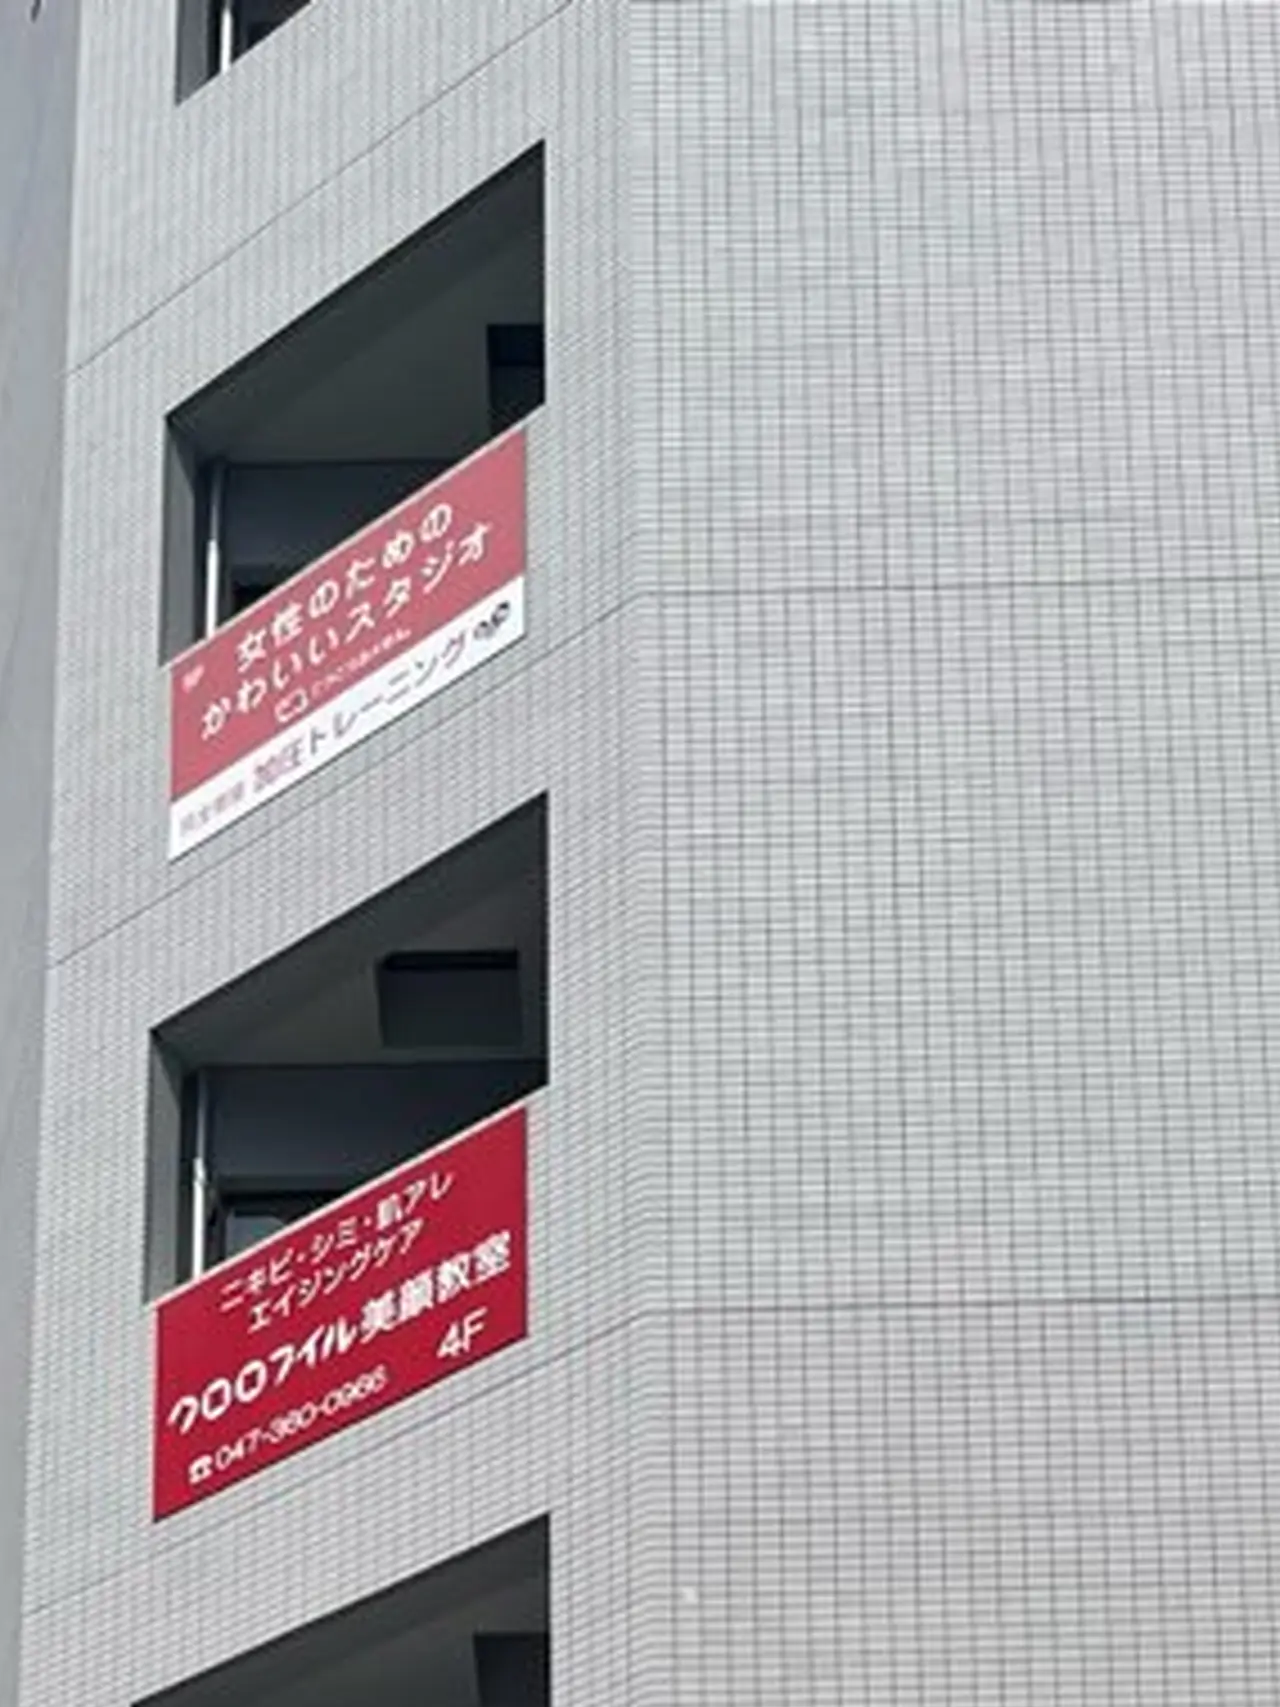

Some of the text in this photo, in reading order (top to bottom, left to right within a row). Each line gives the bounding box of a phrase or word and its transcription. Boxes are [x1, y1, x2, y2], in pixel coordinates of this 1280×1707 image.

[201, 522, 490, 739] かわいいスタジオ
[237, 504, 453, 673] 女性のための
[248, 1218, 425, 1333] エイジングケア
[437, 1306, 488, 1359] 4F
